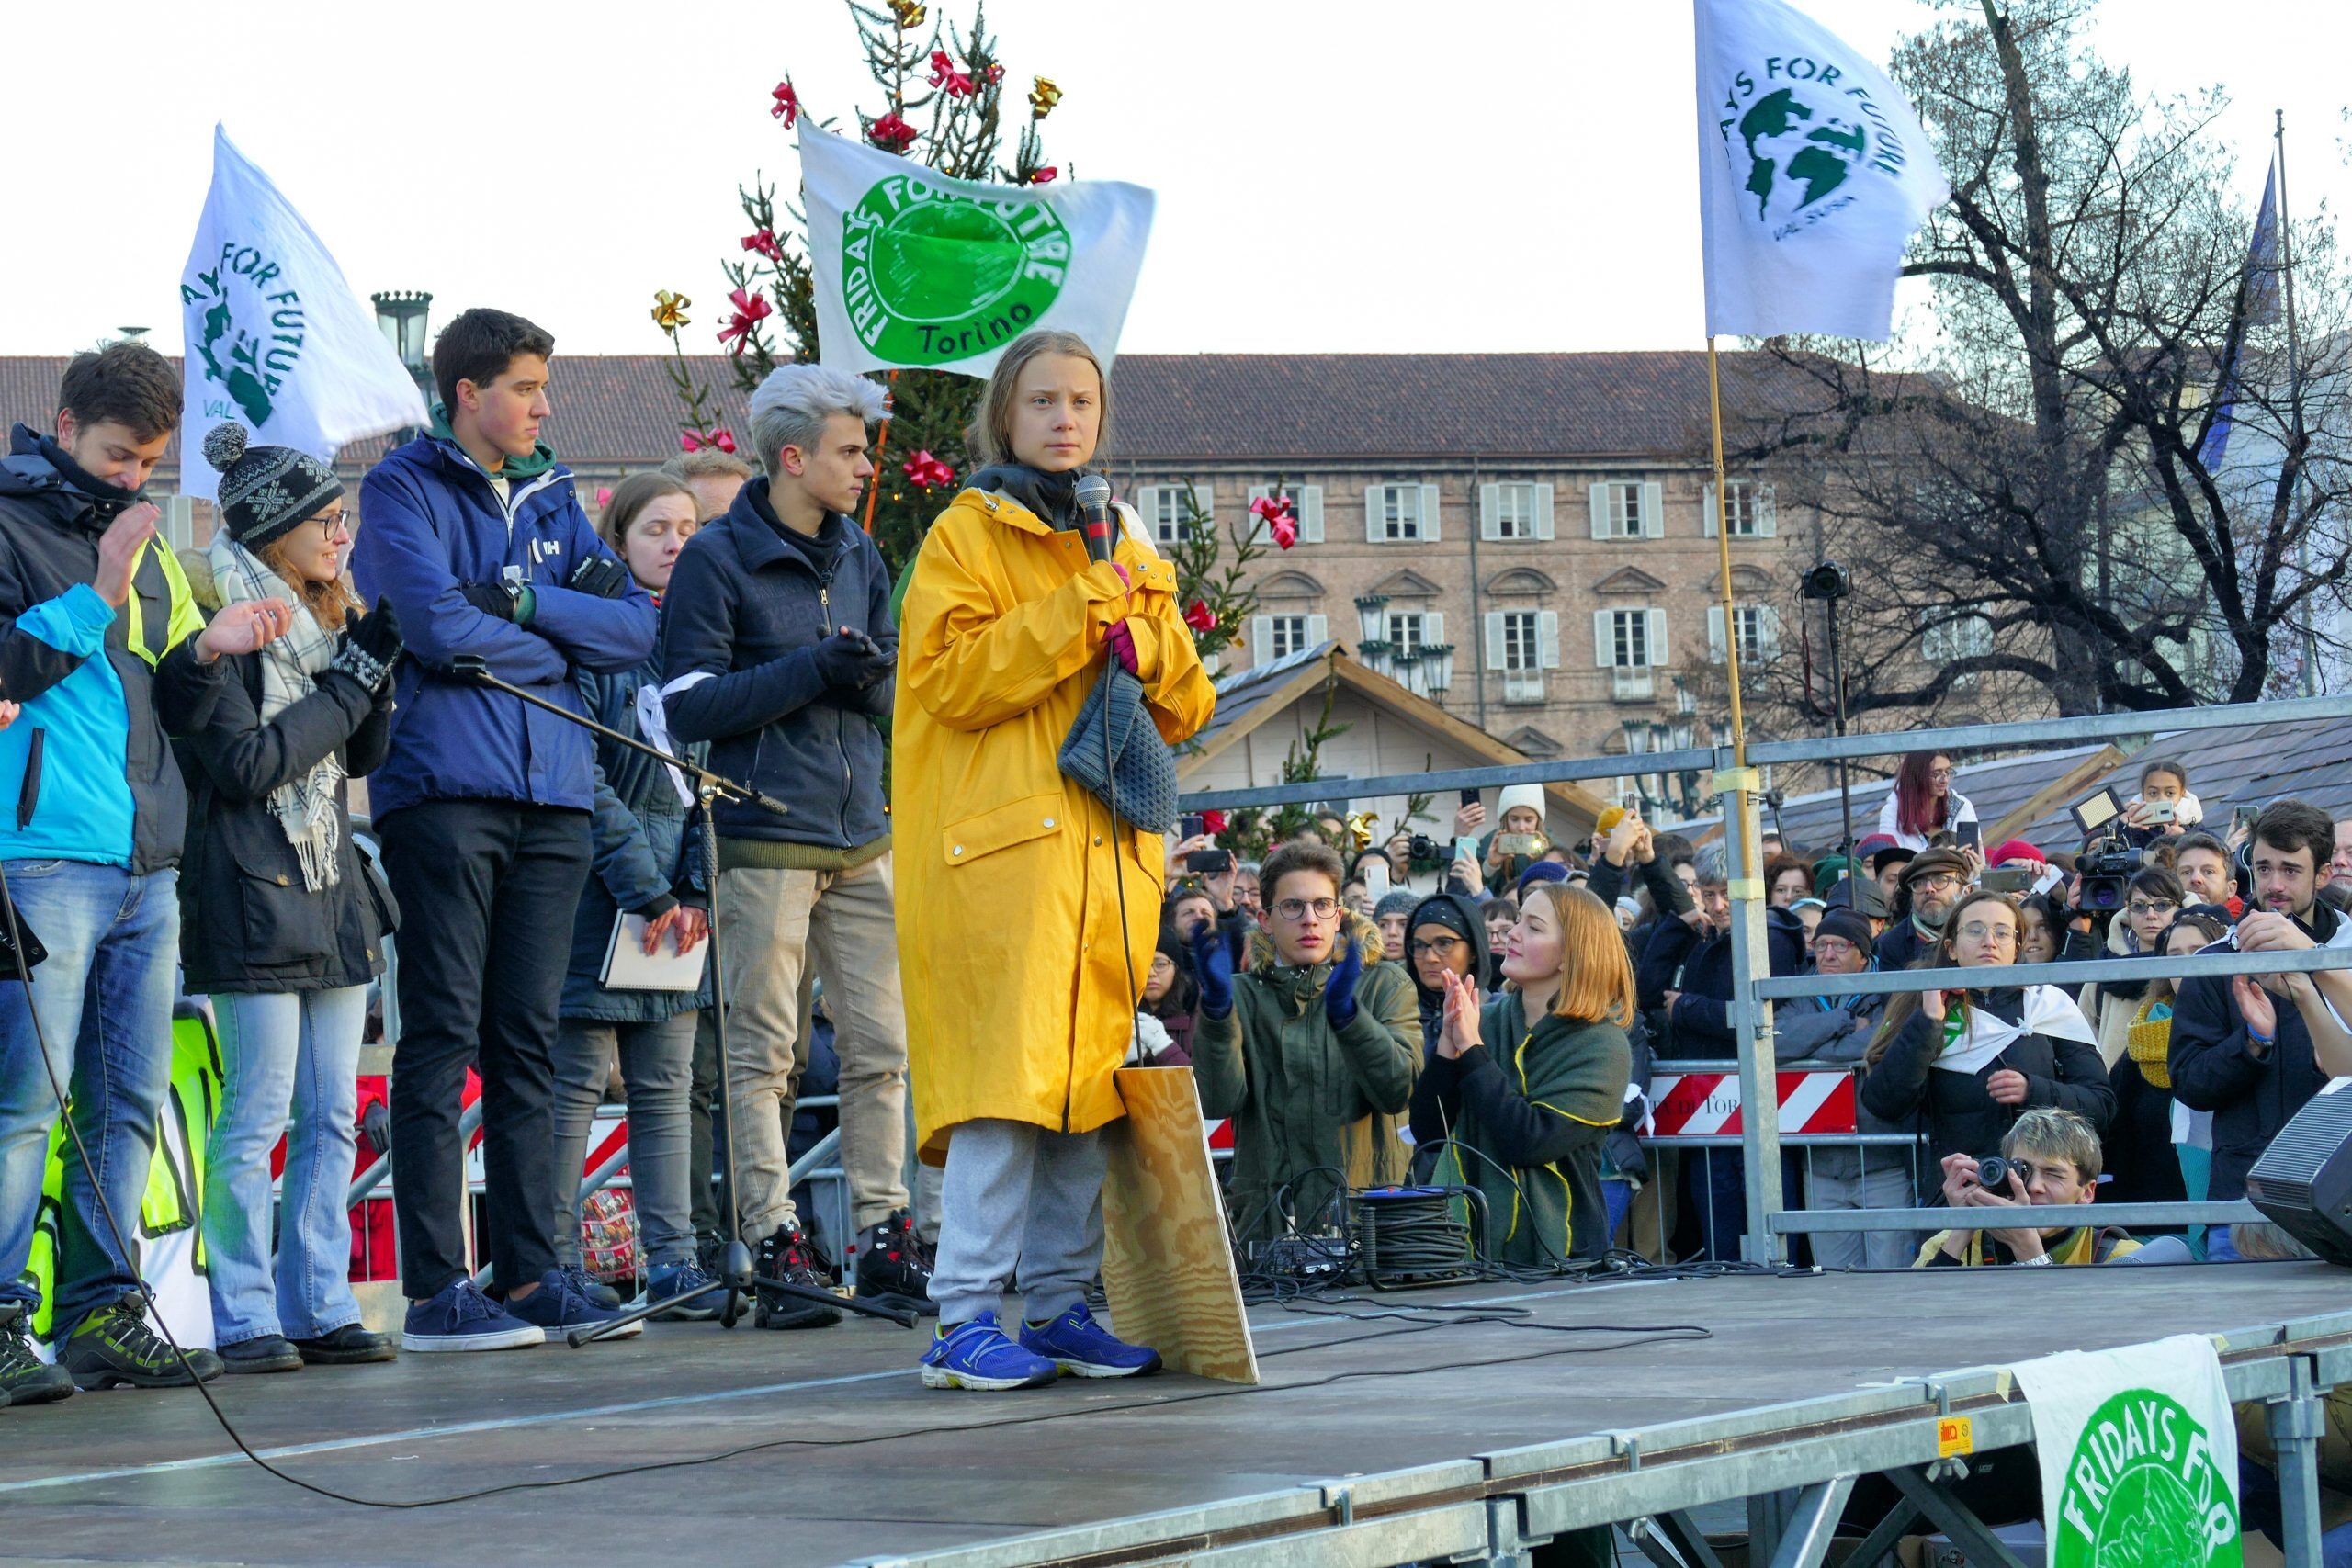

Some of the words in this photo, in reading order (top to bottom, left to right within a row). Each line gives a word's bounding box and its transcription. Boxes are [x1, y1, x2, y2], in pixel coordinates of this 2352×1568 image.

[1765, 56, 1843, 86] FOR
[844, 204, 888, 348] FRIDAYS
[220, 242, 280, 288] FOR
[263, 289, 305, 397] FUTUR
[917, 303, 1031, 355] Torino
[203, 399, 235, 420] VAL
[1702, 1095, 1739, 1114] TOR
[2063, 1400, 2176, 1544] FRIDAYS
[2182, 1430, 2236, 1562] FOR
